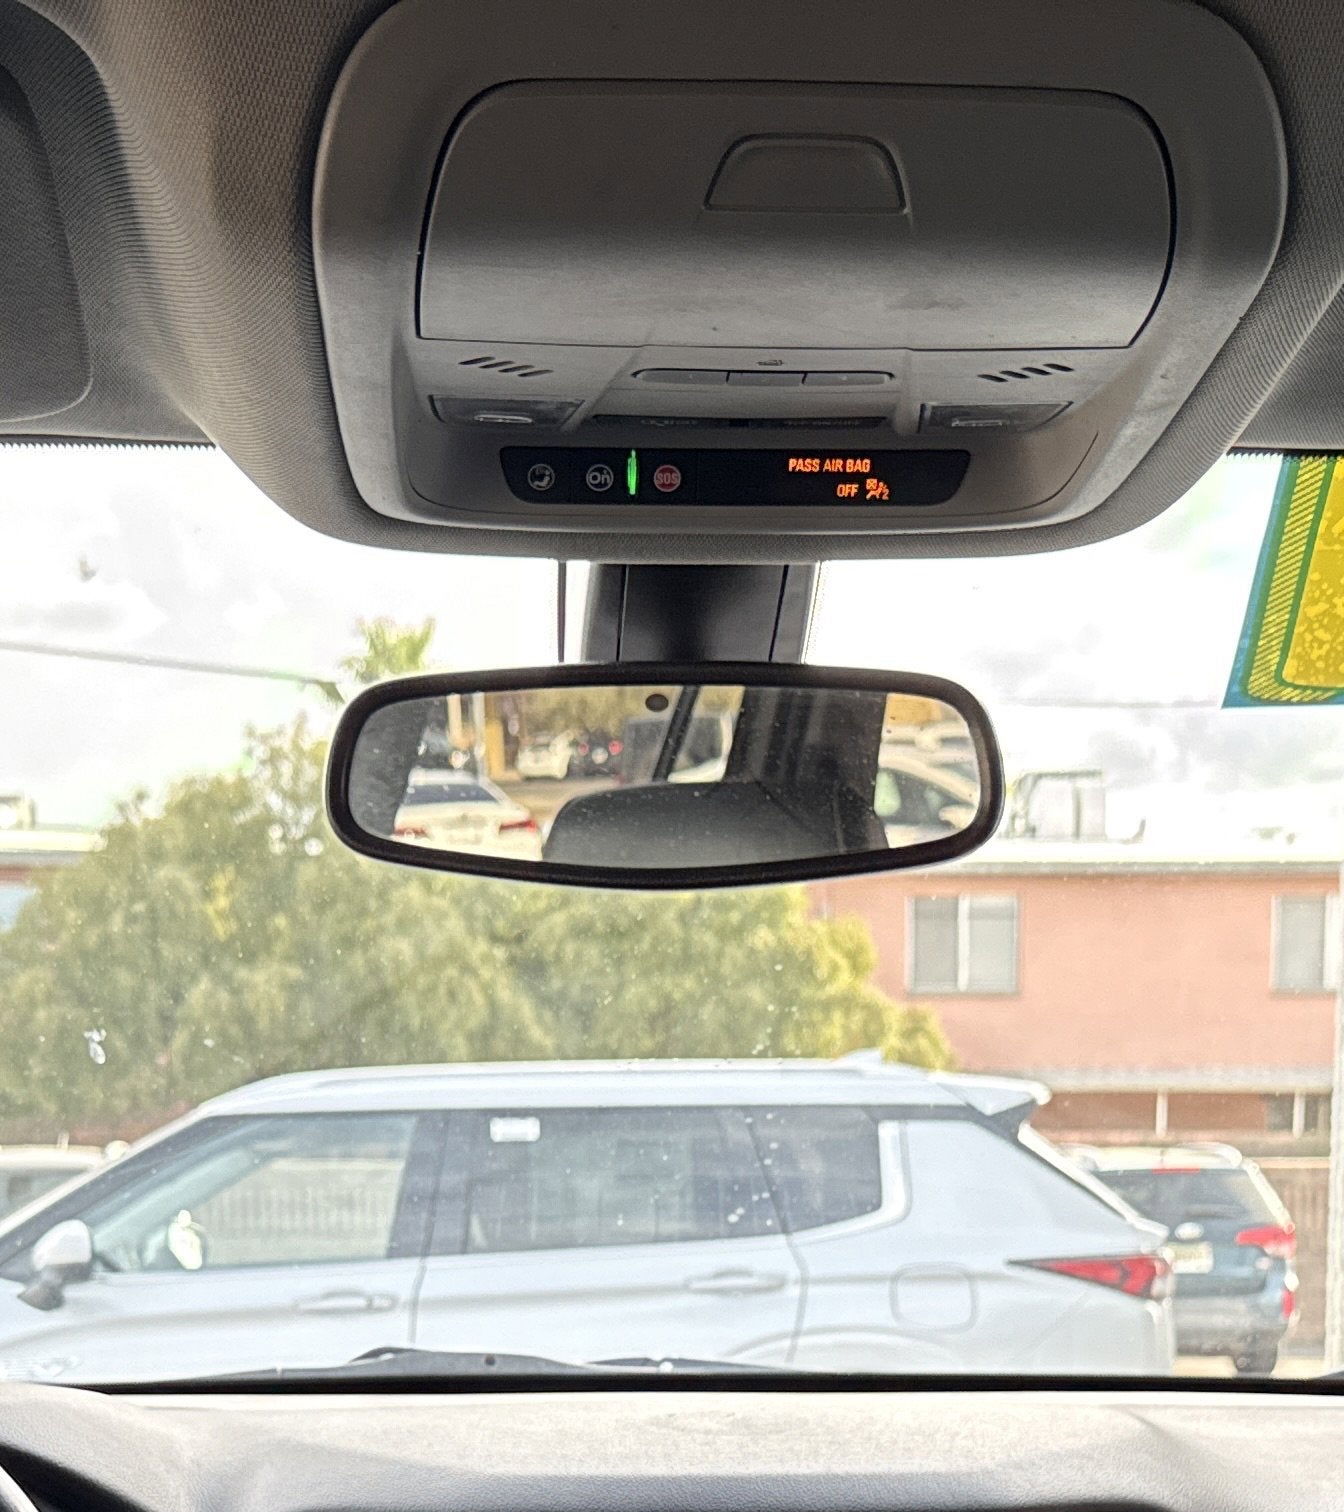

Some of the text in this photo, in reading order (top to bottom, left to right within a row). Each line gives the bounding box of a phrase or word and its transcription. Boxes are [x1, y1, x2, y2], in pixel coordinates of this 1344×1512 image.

[788, 458, 871, 473] PASS AIR BAG
[657, 473, 678, 485] SOS
[837, 483, 859, 497] OFF
